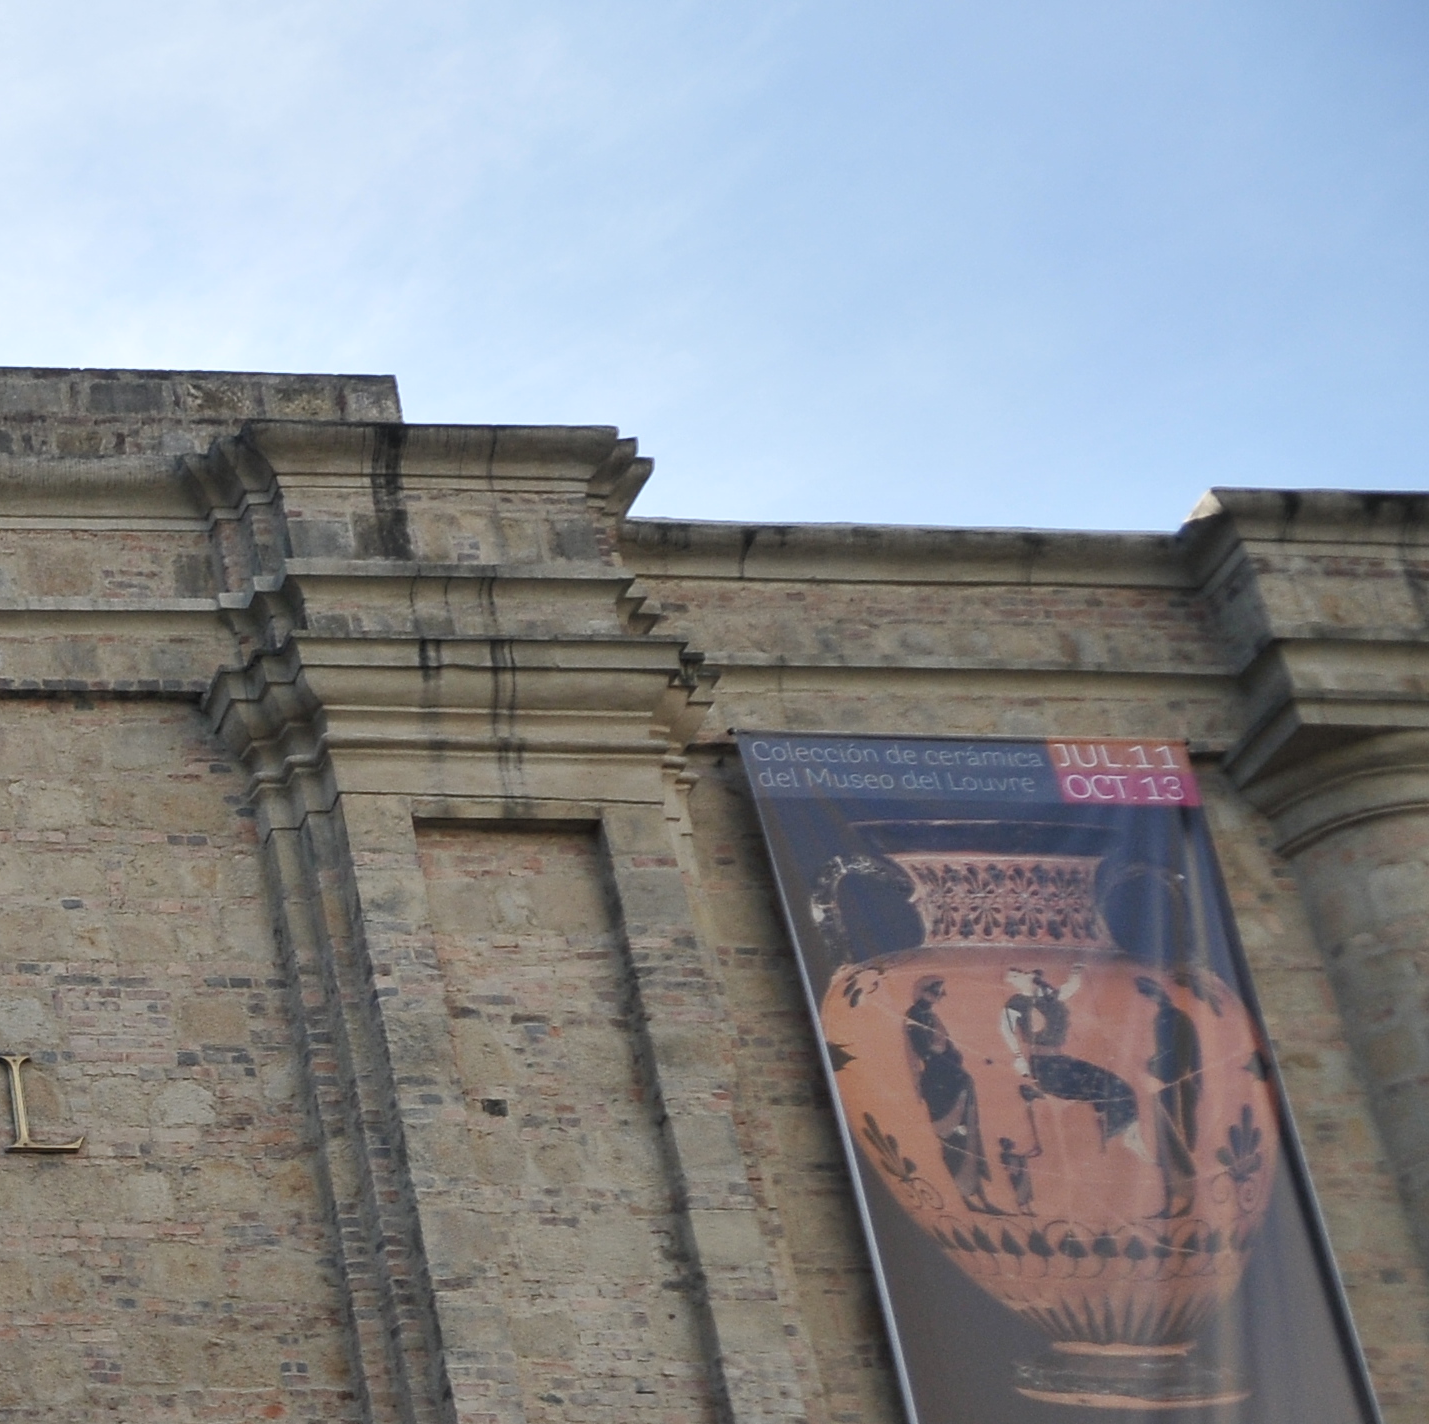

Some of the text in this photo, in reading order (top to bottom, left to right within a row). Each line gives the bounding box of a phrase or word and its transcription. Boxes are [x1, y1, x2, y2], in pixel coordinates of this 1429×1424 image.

[751, 741, 1044, 767] Colección de cerámica
[758, 768, 1036, 792] del Museo del Louvre
